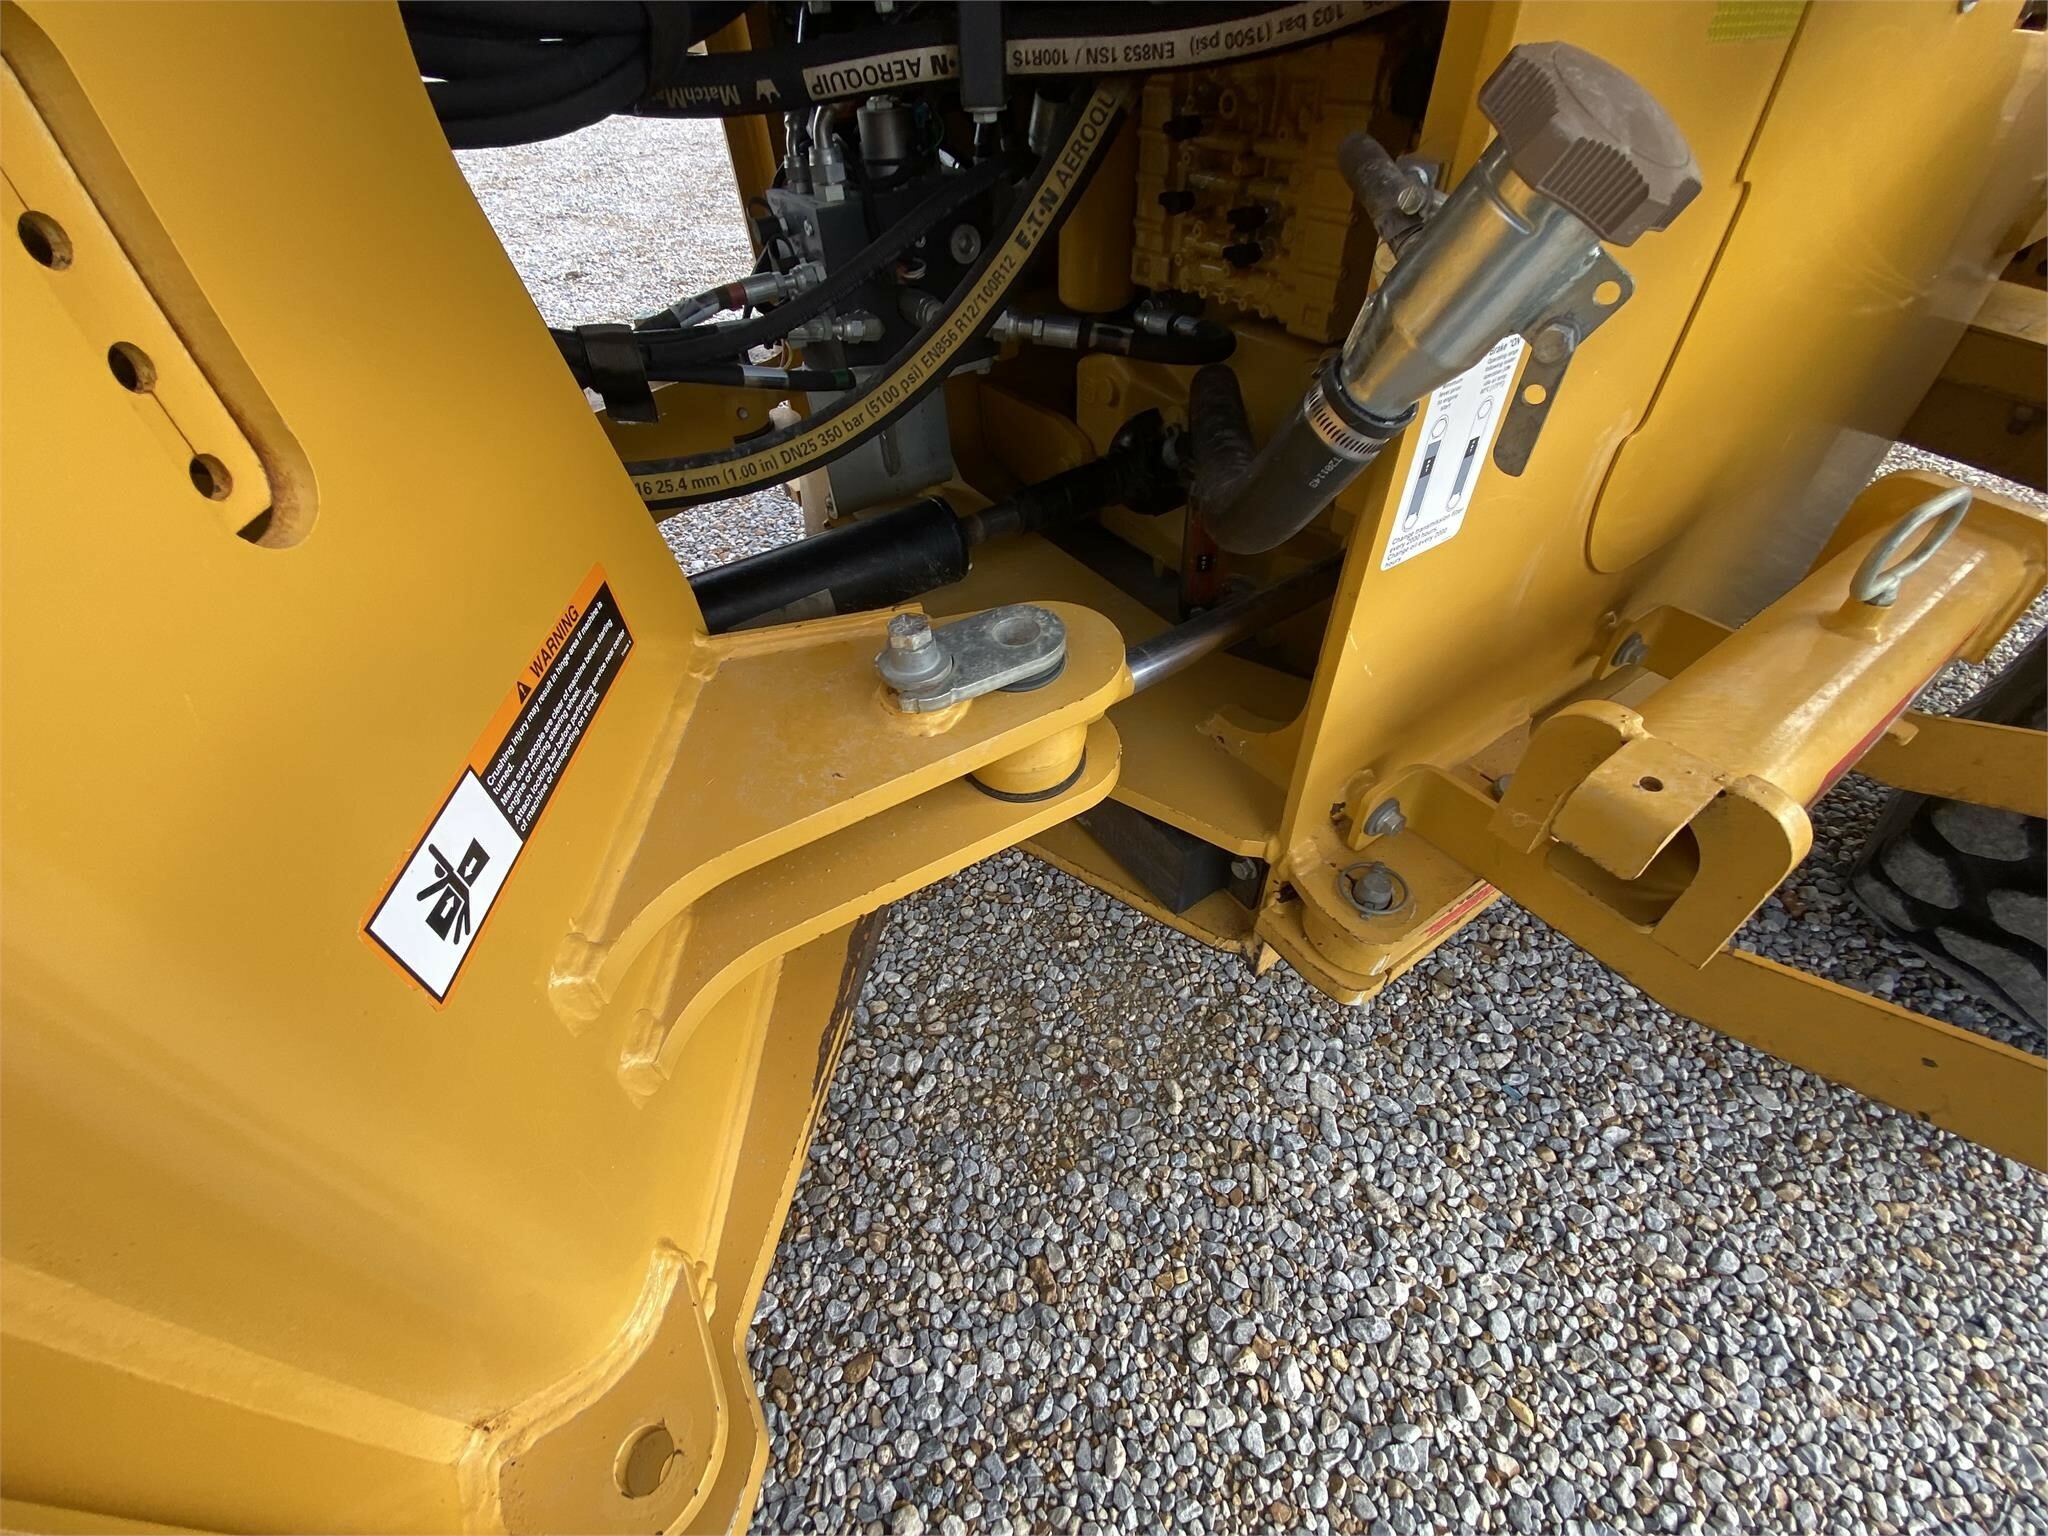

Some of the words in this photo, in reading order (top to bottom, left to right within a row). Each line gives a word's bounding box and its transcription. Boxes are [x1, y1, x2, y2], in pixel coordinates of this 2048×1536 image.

[1224, 28, 1273, 50] (1500
[1277, 15, 1307, 35] bar
[1013, 50, 1068, 67] 100R1S
[1087, 47, 1117, 64] 1SN
[1124, 41, 1175, 62] EN853
[1190, 34, 1220, 57] psi)
[812, 57, 921, 95] AEROQUIP
[655, 84, 741, 108] MatchM
[657, 478, 687, 494] 25.4
[691, 474, 720, 490] mm
[723, 462, 758, 484] (1.00
[759, 455, 779, 475] in)
[781, 438, 818, 464] DN25
[821, 425, 843, 446] 350
[844, 411, 865, 432] bar
[865, 386, 900, 418] (5100
[900, 366, 924, 394] psi)
[920, 329, 958, 369] EN856
[954, 254, 1017, 334] R12/100R12
[530, 604, 579, 678] WARNING
[487, 744, 515, 786] Crushing
[511, 721, 529, 746] injury
[527, 703, 540, 722] may
[538, 680, 553, 705] result
[556, 654, 570, 675] hinge
[569, 639, 580, 655] area
[581, 608, 599, 635] machine
[500, 780, 518, 806] Make
[516, 760, 529, 781] sure
[528, 732, 546, 763] people
[544, 719, 553, 733] are
[552, 700, 564, 720] clear
[568, 662, 586, 693] machine
[584, 642, 599, 664] before
[597, 619, 613, 644] starting
[515, 794, 533, 825] Attach
[530, 762, 551, 794] locking
[548, 747, 558, 764] bar
[556, 724, 572, 750] before
[570, 686, 593, 726] performing
[592, 662, 606, 687] service
[605, 648, 614, 664] near
[613, 629, 625, 650] center
[508, 783, 527, 814] engine
[531, 741, 551, 773] moving
[549, 710, 569, 742] steering
[566, 687, 582, 711] wheel.
[526, 783, 548, 822] machine
[552, 726, 580, 774] transporting
[586, 690, 599, 711] truck.
[493, 763, 515, 795] turned.
